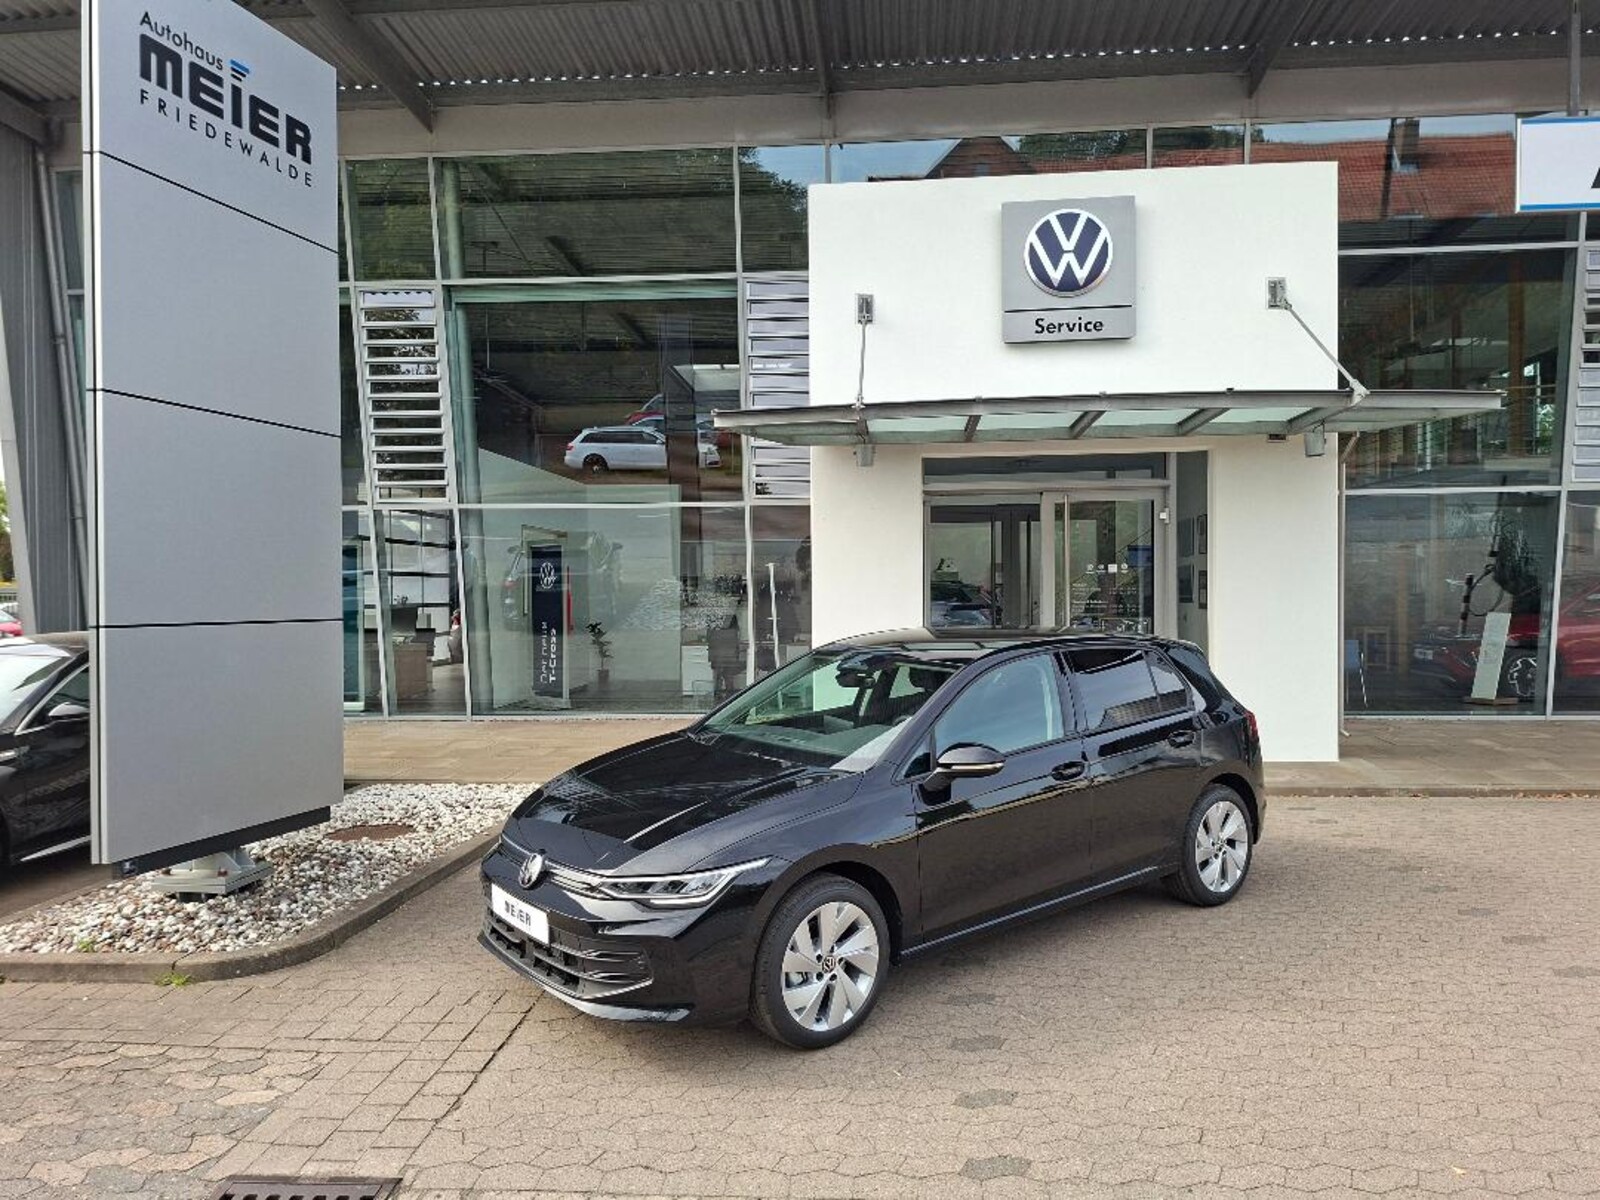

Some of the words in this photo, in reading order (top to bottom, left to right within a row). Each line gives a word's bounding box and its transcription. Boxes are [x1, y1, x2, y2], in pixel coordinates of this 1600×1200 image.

[139, 11, 223, 71] Autohaus
[140, 88, 312, 188] FRIEDEWALDE
[1034, 317, 1104, 334] Service
[549, 627, 557, 684] T-Cross
